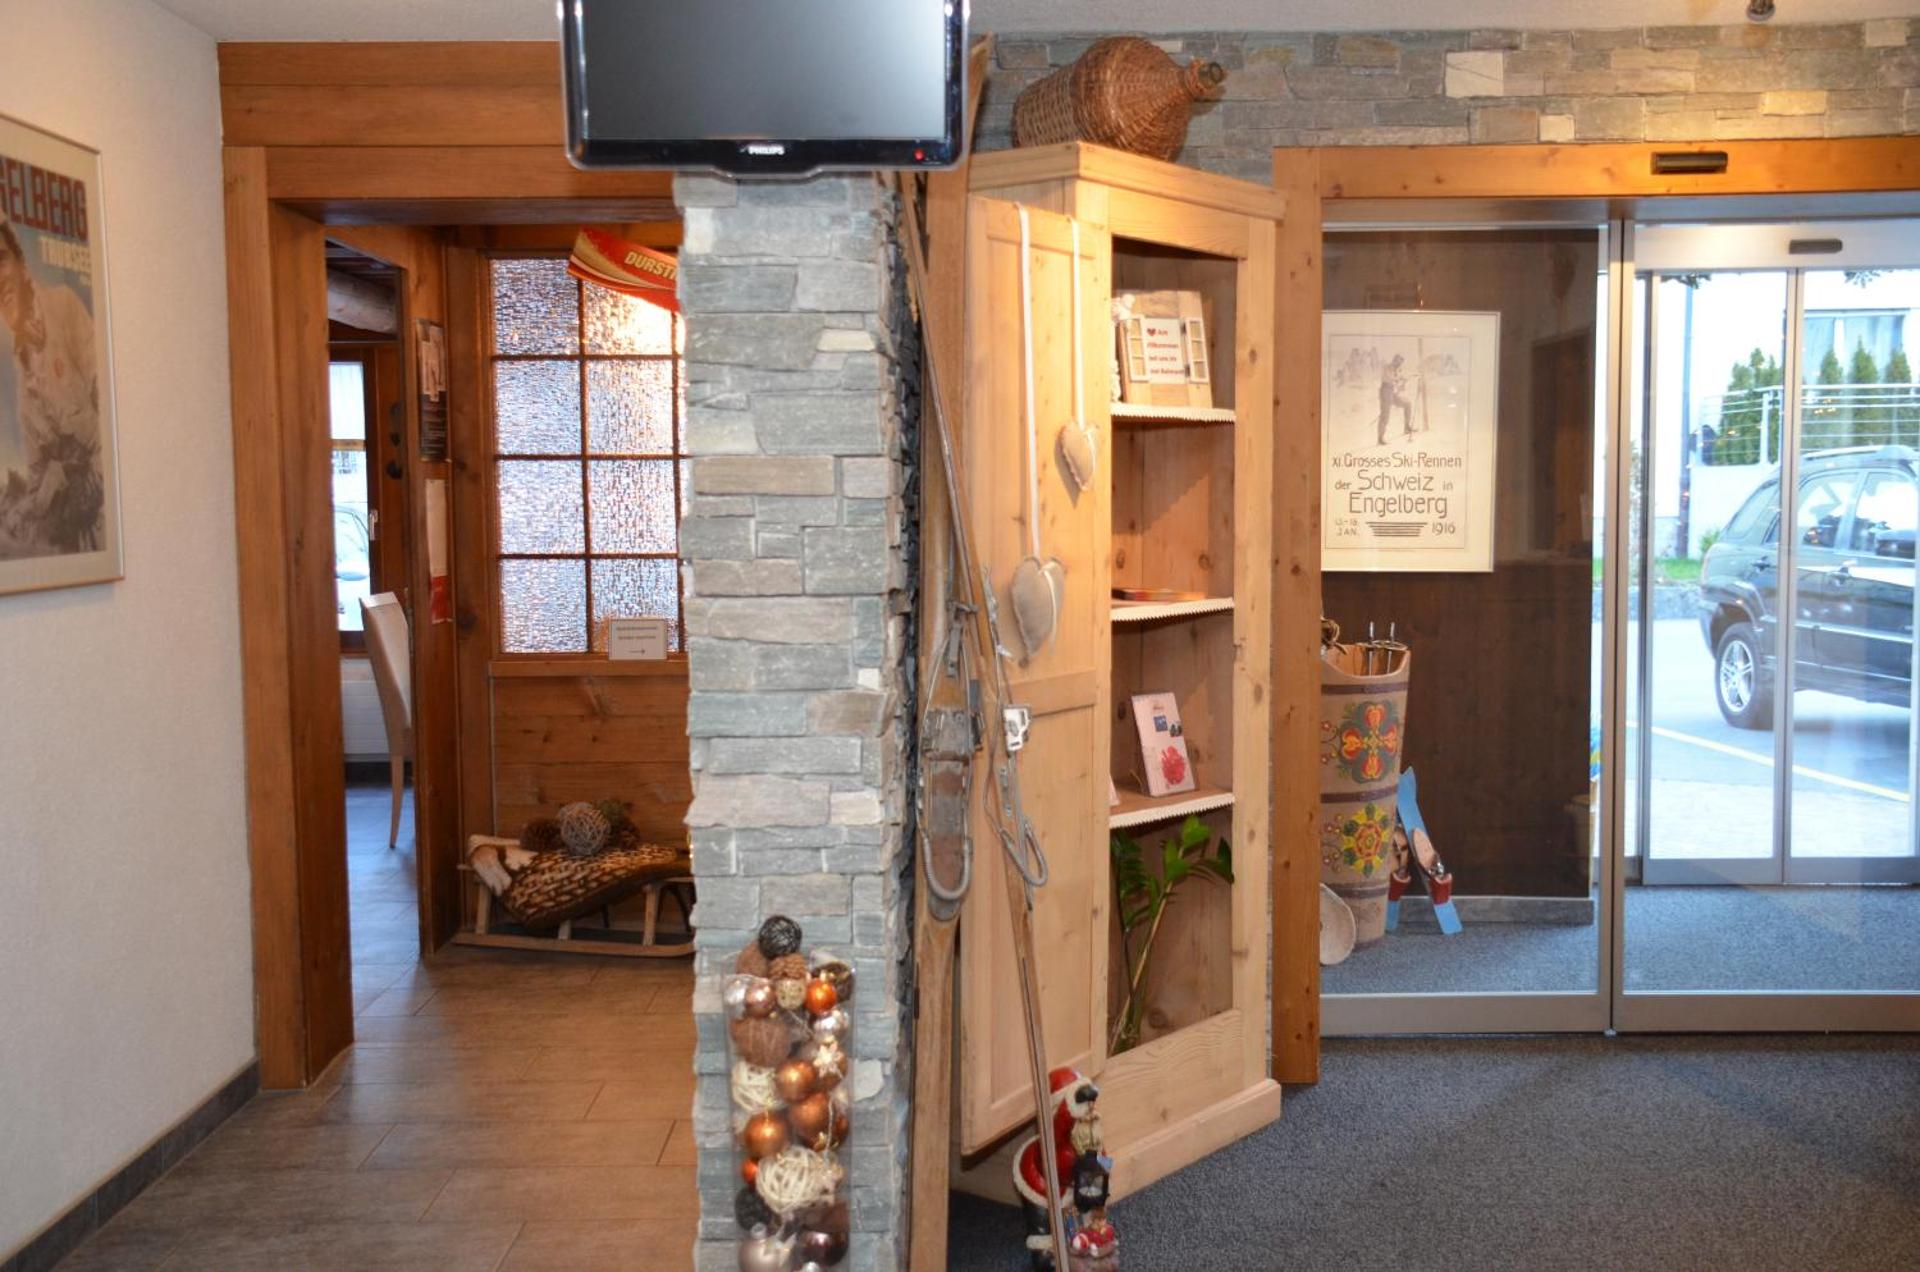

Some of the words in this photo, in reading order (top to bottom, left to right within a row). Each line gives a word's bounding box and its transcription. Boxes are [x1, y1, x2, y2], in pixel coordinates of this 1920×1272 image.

[1343, 453, 1391, 468] Grosses
[1391, 452, 1462, 468] Ski-Rennen
[1334, 480, 1351, 490] der
[1357, 469, 1434, 491] Schweiz
[1442, 480, 1453, 491] in
[1349, 491, 1447, 519] Engelberg
[1432, 522, 1456, 536] 1916
